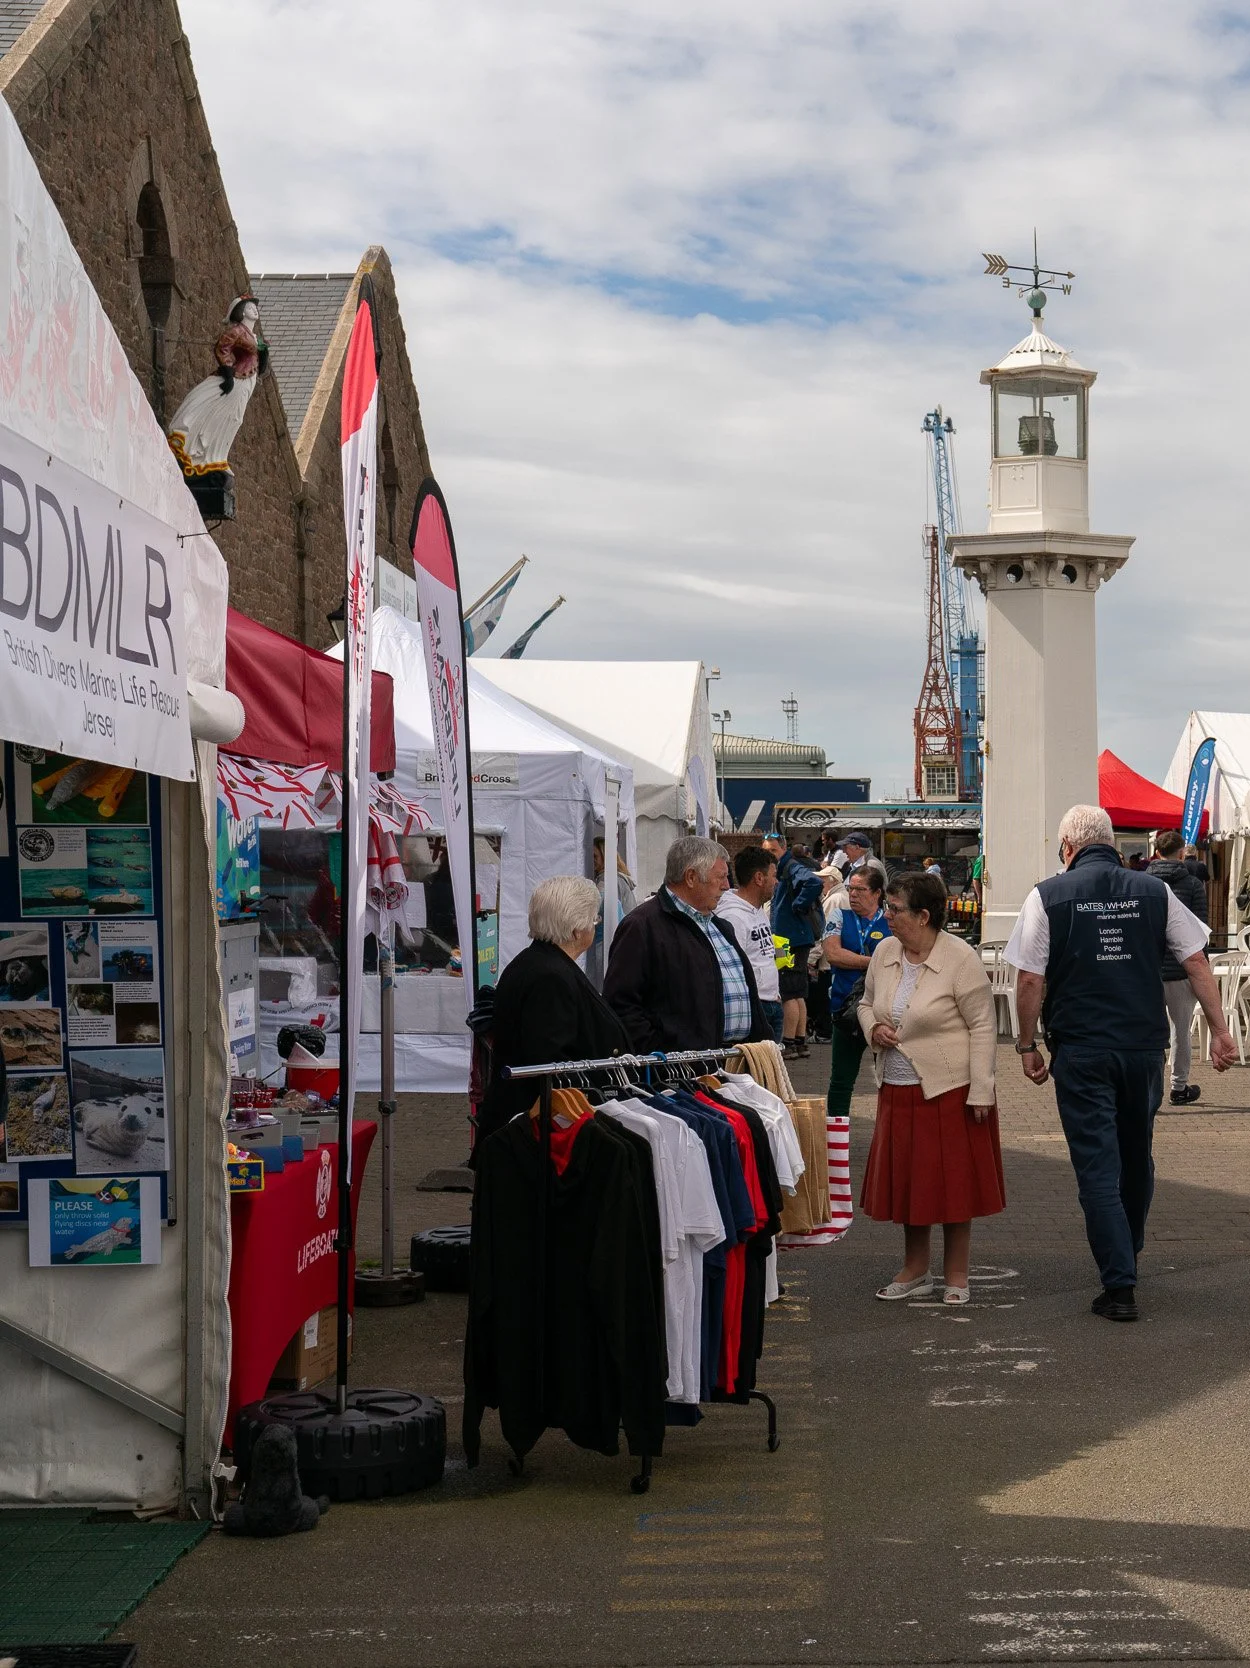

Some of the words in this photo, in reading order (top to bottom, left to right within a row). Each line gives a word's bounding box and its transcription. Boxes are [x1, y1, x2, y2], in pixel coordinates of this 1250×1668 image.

[0, 463, 177, 677] BDMLR
[4, 629, 43, 676] British
[43, 645, 77, 690] Divers
[79, 659, 117, 701] Marine
[119, 672, 147, 708] Life
[1096, 953, 1132, 961] Eastbourne
[54, 1201, 93, 1211] PLEASE
[54, 1220, 74, 1228] flying
